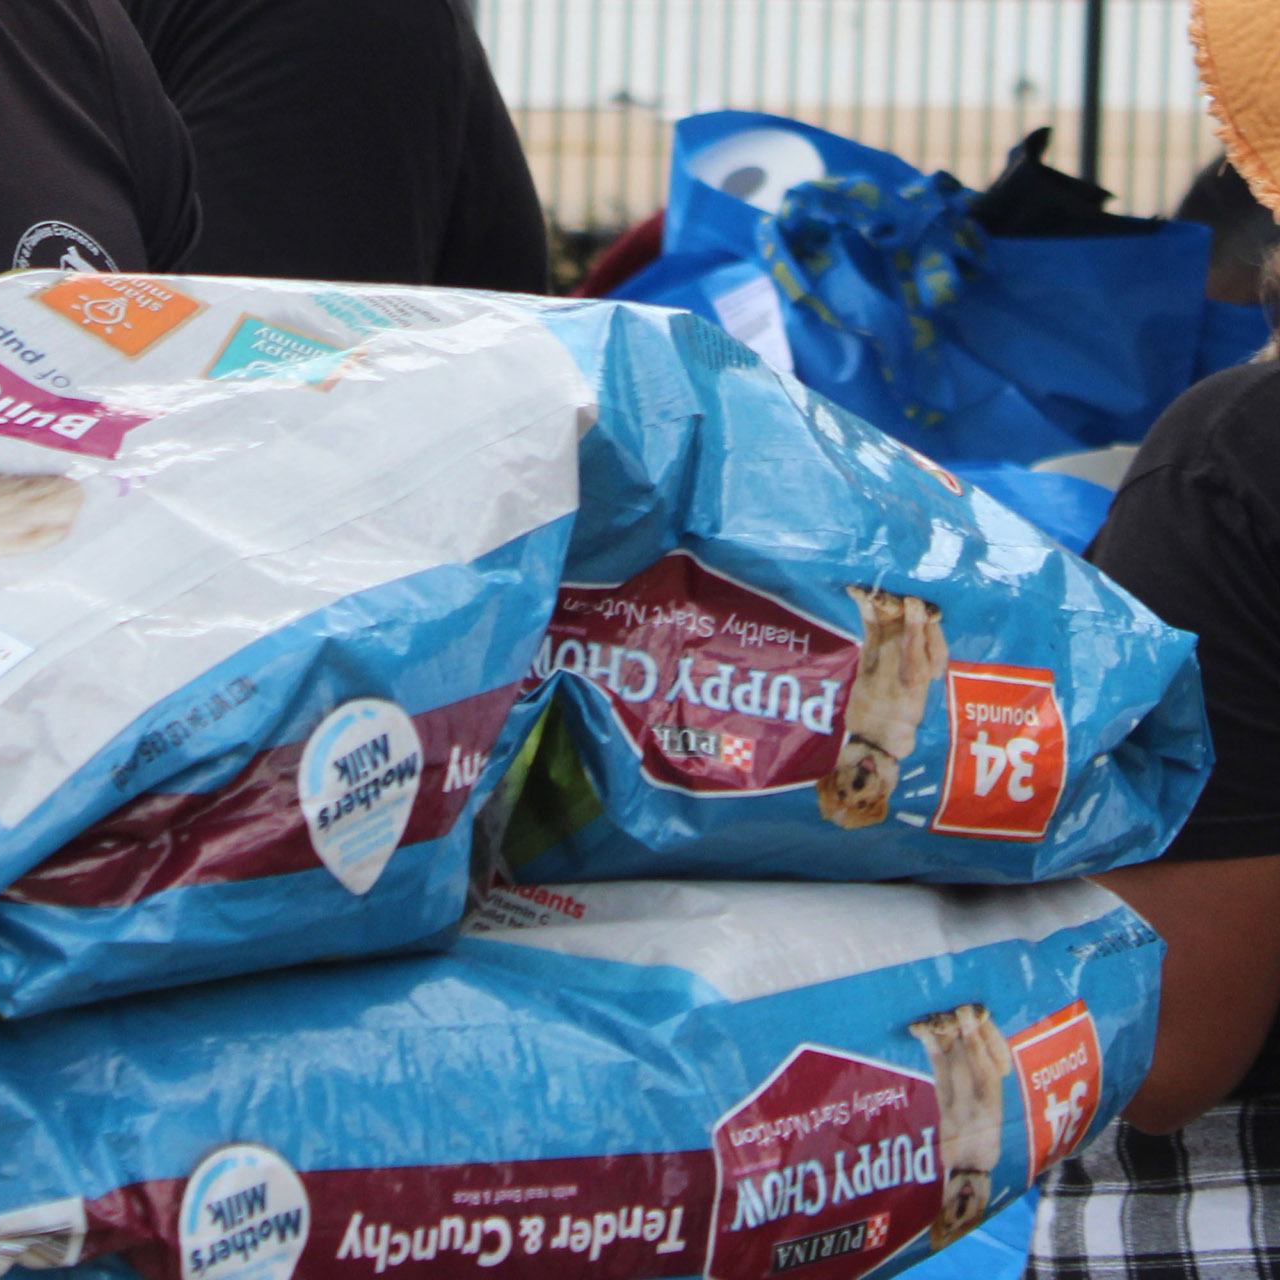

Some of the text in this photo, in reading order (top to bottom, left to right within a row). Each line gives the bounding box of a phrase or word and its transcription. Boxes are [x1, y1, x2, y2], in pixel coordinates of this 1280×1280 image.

[40, 365, 71, 391] of
[651, 603, 716, 638] Start
[720, 613, 812, 655] Healthy
[666, 657, 842, 735] PUPPY
[964, 701, 1040, 727] pounds
[332, 732, 392, 788] Milk
[970, 730, 1040, 803] 34
[319, 751, 419, 830] Mother's
[1030, 1046, 1089, 1091] pounds
[729, 1084, 910, 1148] Healthy Start Nutrition
[1043, 1080, 1088, 1154] 34
[206, 1181, 268, 1232] Milk
[728, 1125, 938, 1234] PUPPY CHOW
[190, 1206, 303, 1274] Mother's
[336, 1206, 686, 1274] Tender & Crunchy
[775, 1226, 865, 1271] PURINA
